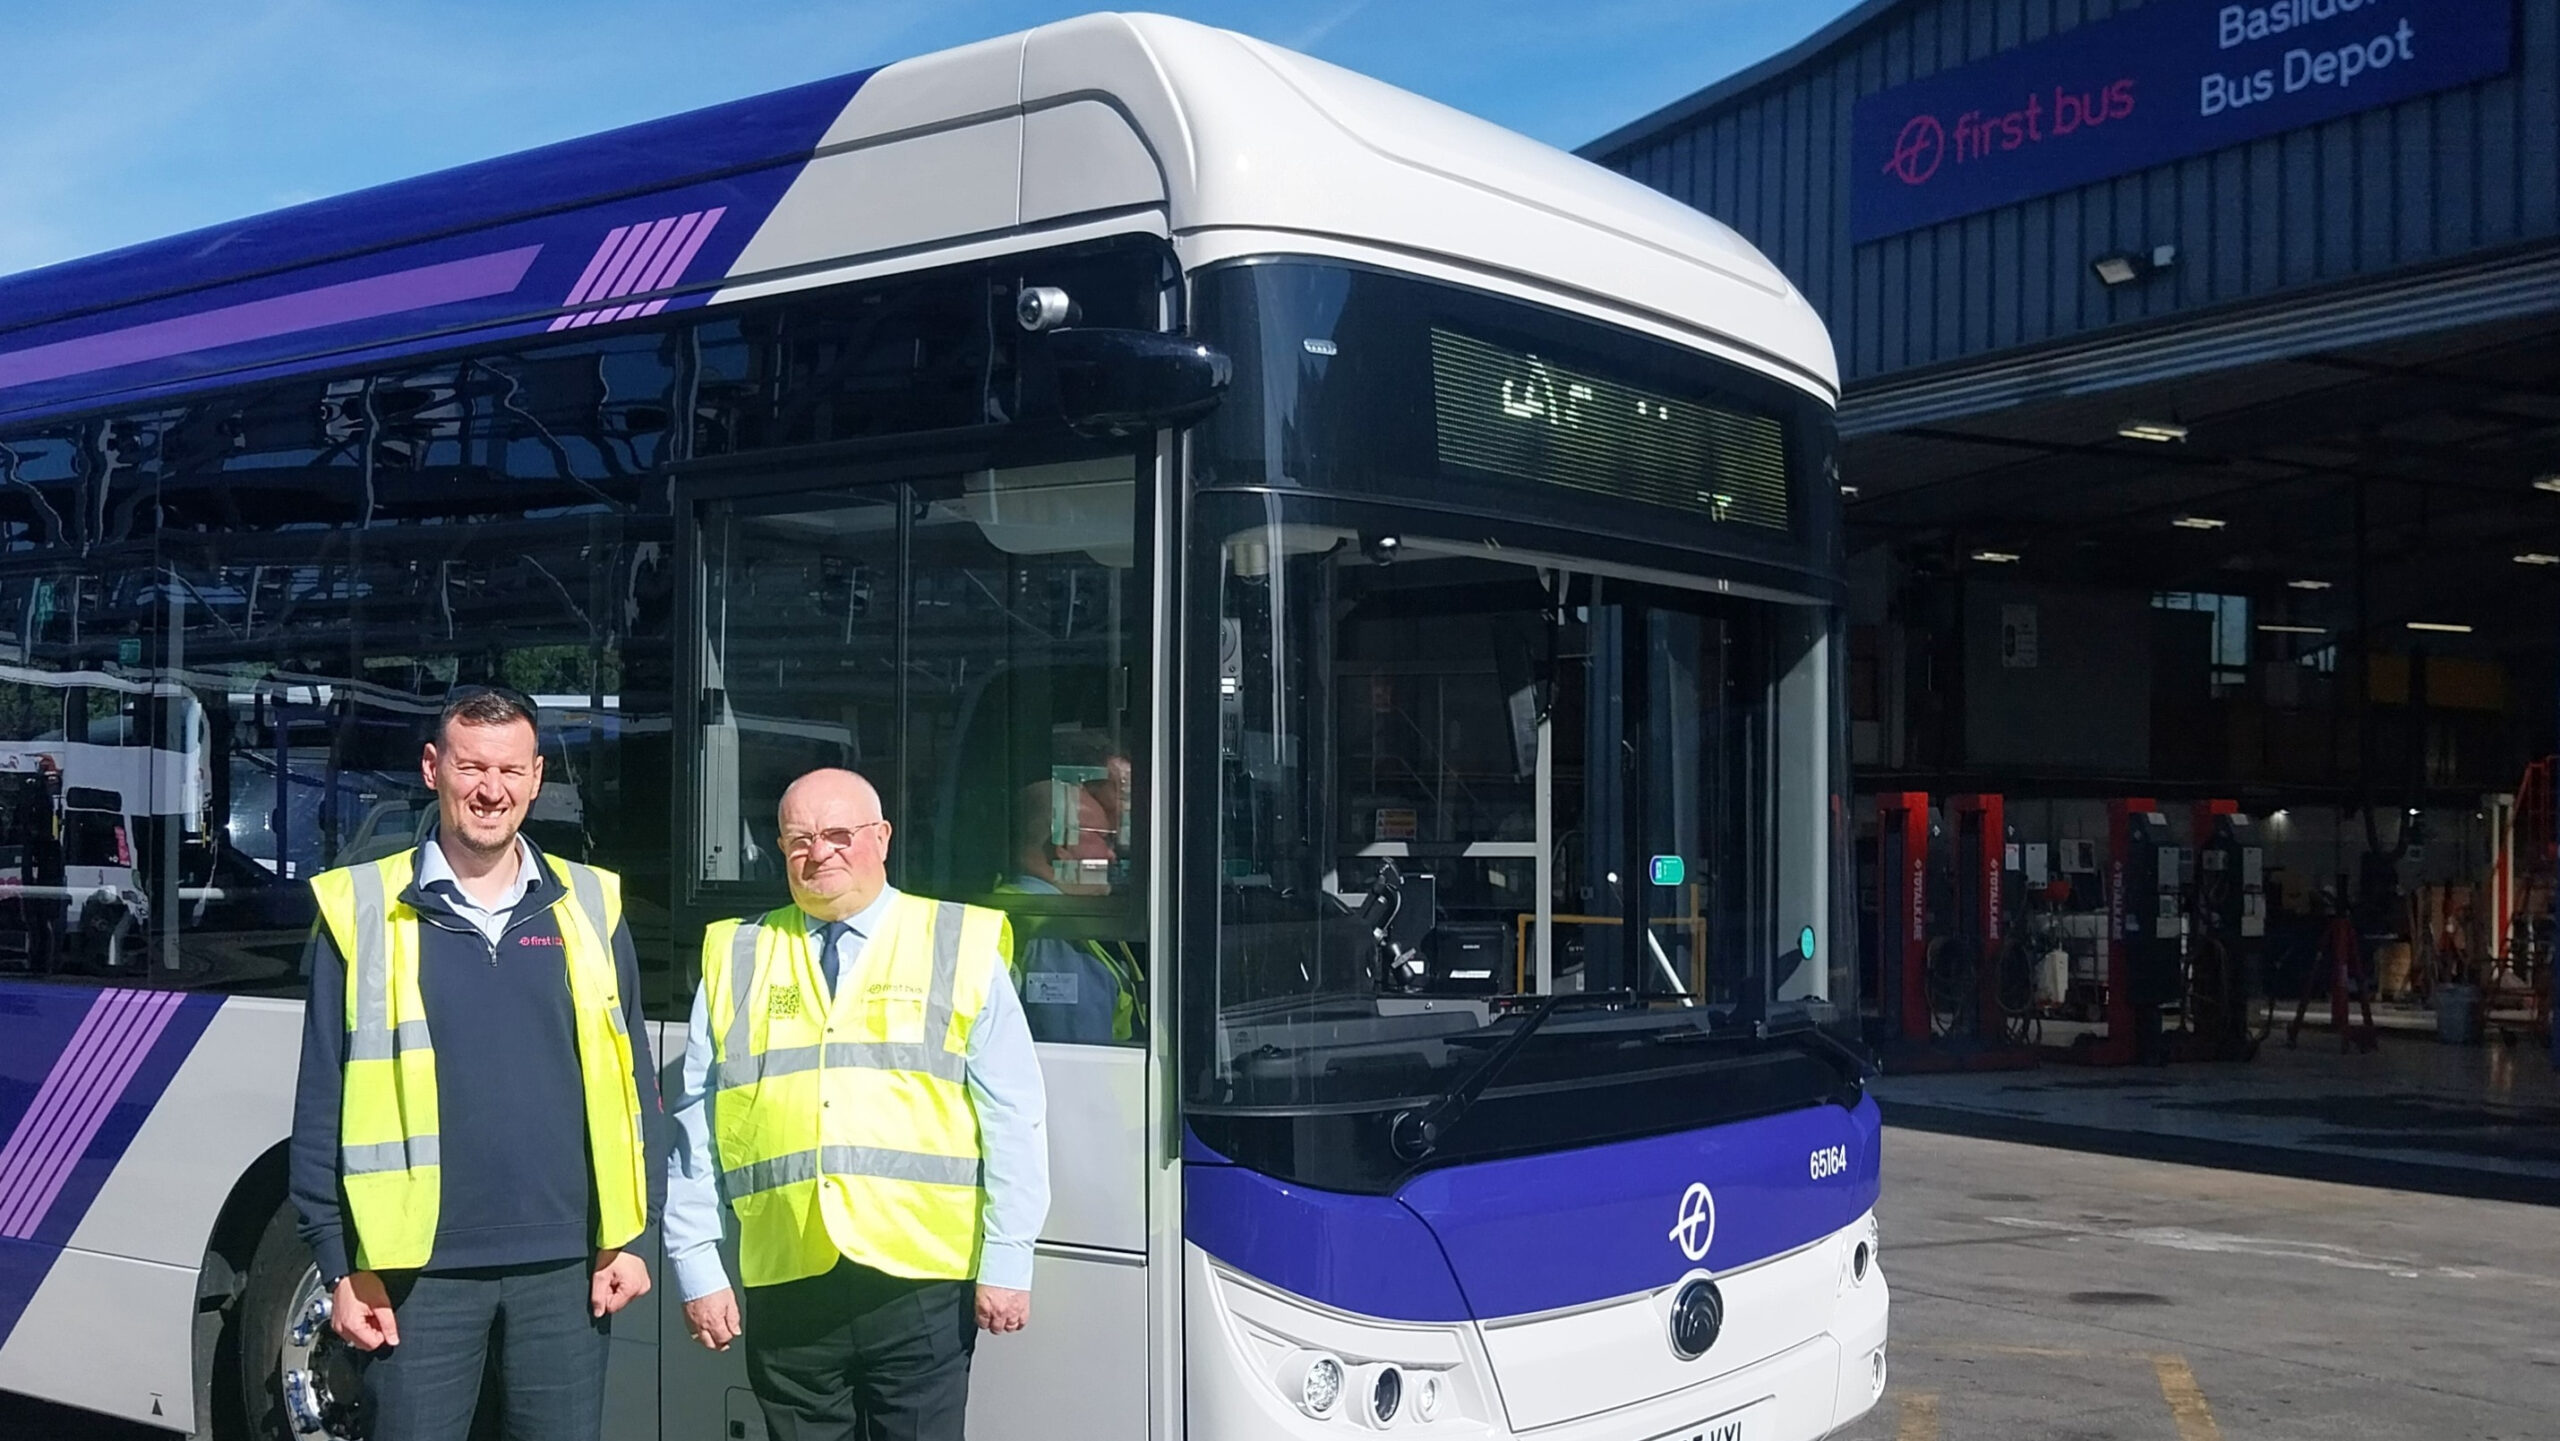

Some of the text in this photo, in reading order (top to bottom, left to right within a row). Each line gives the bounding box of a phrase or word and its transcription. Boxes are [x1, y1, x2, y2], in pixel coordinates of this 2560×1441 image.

[2218, 0, 2377, 49] Basild
[2200, 17, 2416, 117] Bus Depot
[1953, 78, 2136, 164] first bus
[530, 935, 551, 946] first
[1810, 1144, 1847, 1180] 65164
